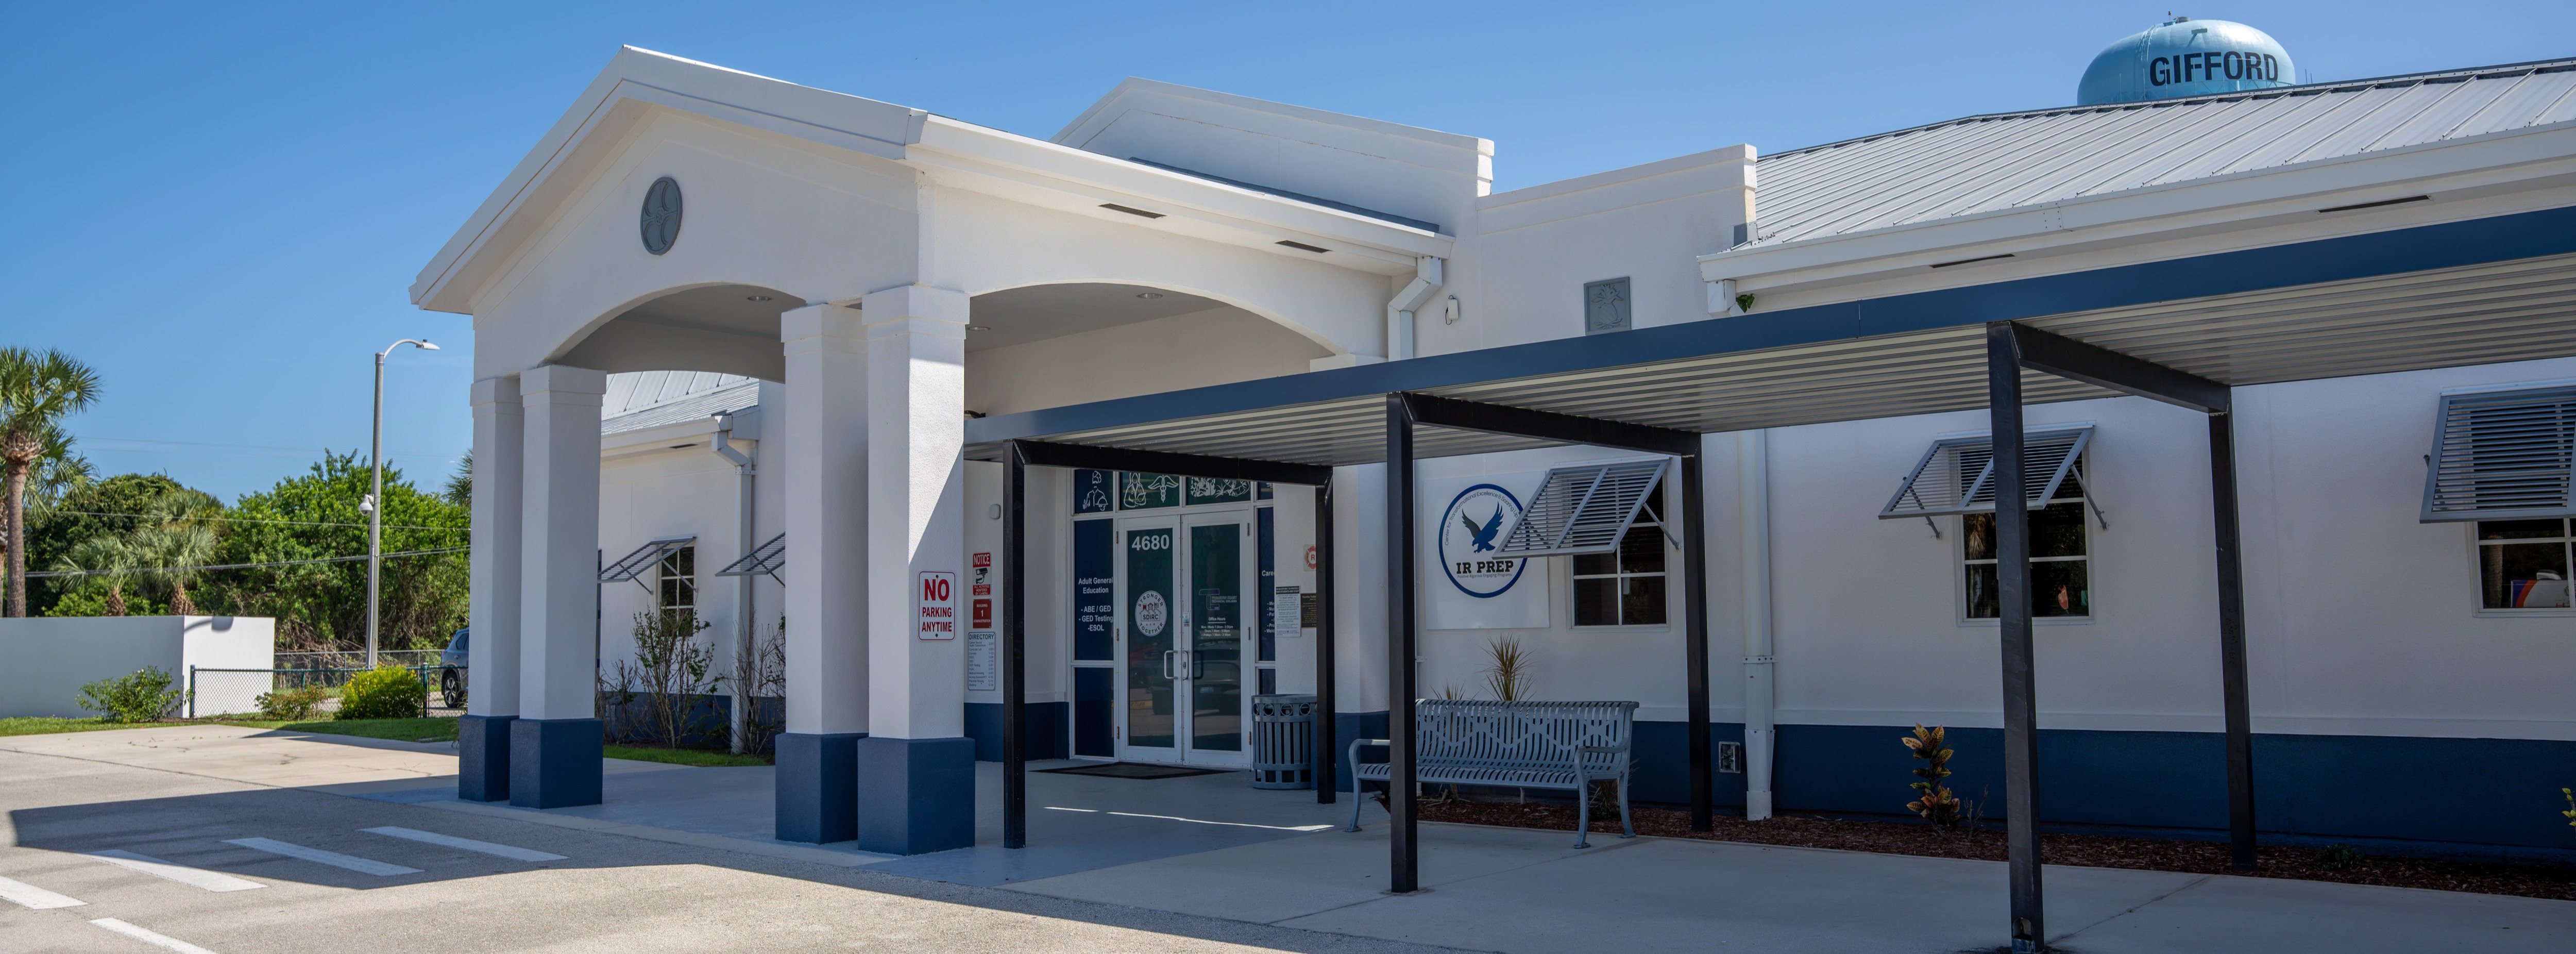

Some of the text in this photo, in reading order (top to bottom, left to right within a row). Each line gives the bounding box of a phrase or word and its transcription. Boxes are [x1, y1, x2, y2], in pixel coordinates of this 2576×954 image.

[2150, 51, 2278, 86] GIFFORD
[1449, 493, 1476, 521] Transformational
[1501, 496, 1515, 512] Soaring
[1513, 510, 1518, 518] Up
[1131, 534, 1170, 550] 4680
[974, 554, 990, 565] NOTICE
[1456, 560, 1514, 574] IR PREP
[925, 579, 950, 601] NO
[1138, 593, 1163, 607] STRONGER
[922, 607, 952, 617] PARKING
[922, 621, 952, 632] ANYTIME
[1139, 622, 1163, 634] TOGETHER
